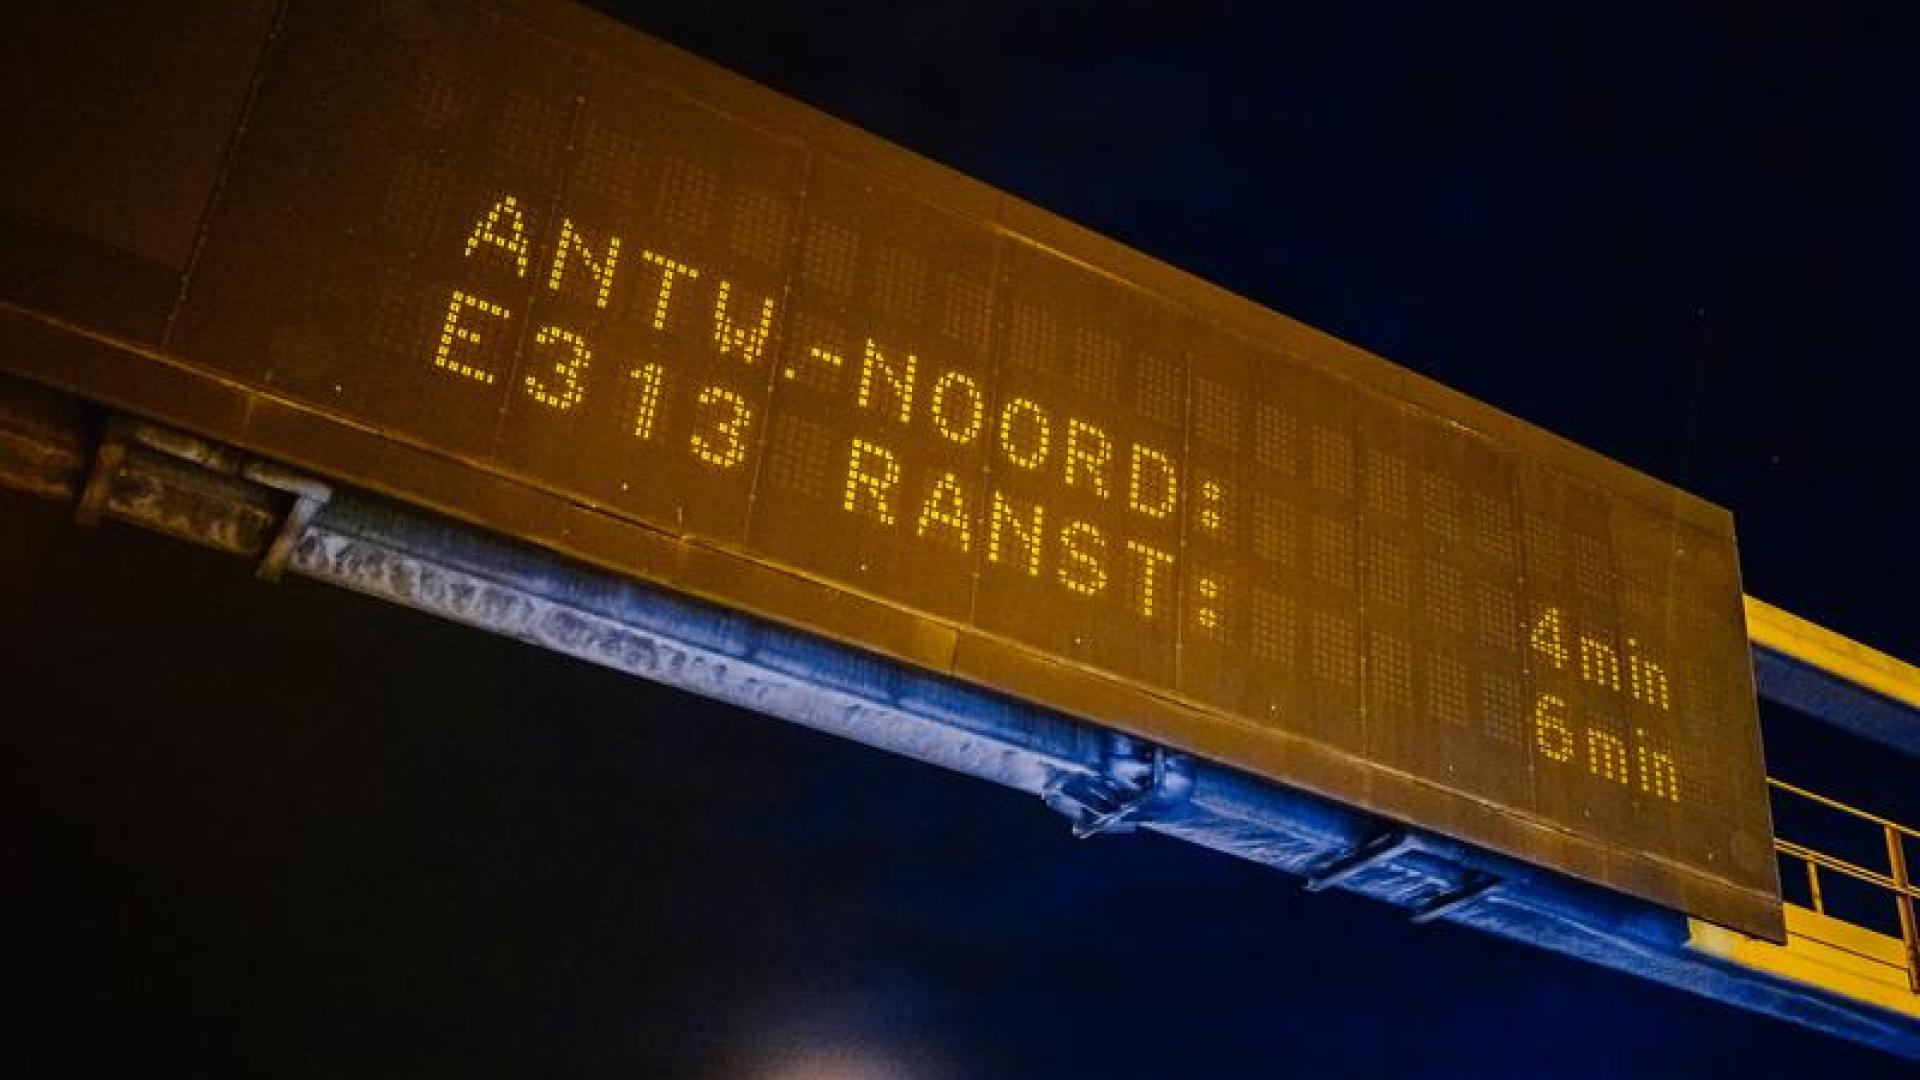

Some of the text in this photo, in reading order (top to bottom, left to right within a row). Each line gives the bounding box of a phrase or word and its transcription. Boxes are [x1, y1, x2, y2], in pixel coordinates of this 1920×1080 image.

[436, 290, 751, 467] E313
[844, 438, 1217, 628] RANST:
[465, 195, 1220, 530] ANTW.-NOORD:
